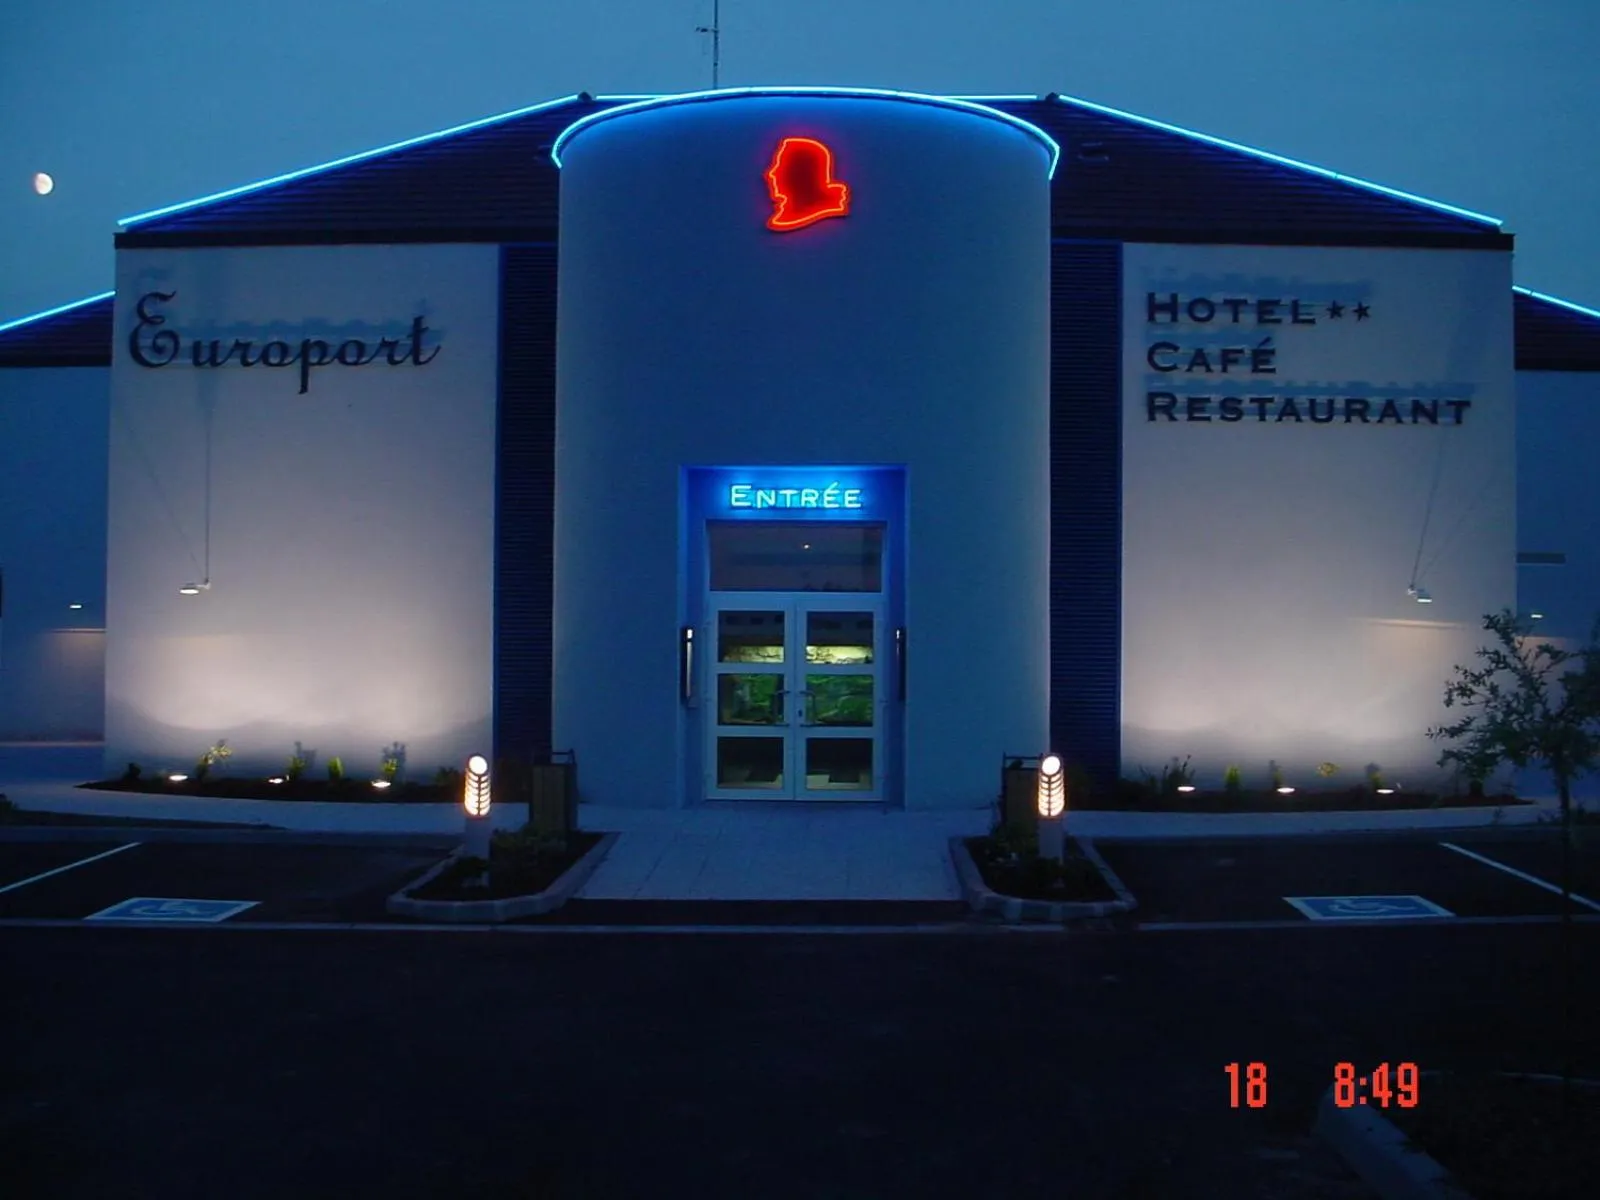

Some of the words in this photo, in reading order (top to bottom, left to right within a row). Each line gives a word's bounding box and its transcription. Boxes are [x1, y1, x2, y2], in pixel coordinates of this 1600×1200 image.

[1147, 292, 1316, 325] HOTEL
[129, 290, 441, 394] Europort
[1146, 336, 1277, 374] CAFÉ
[1146, 391, 1472, 425] RESTAURANT
[730, 482, 862, 509] ENTRÉE
